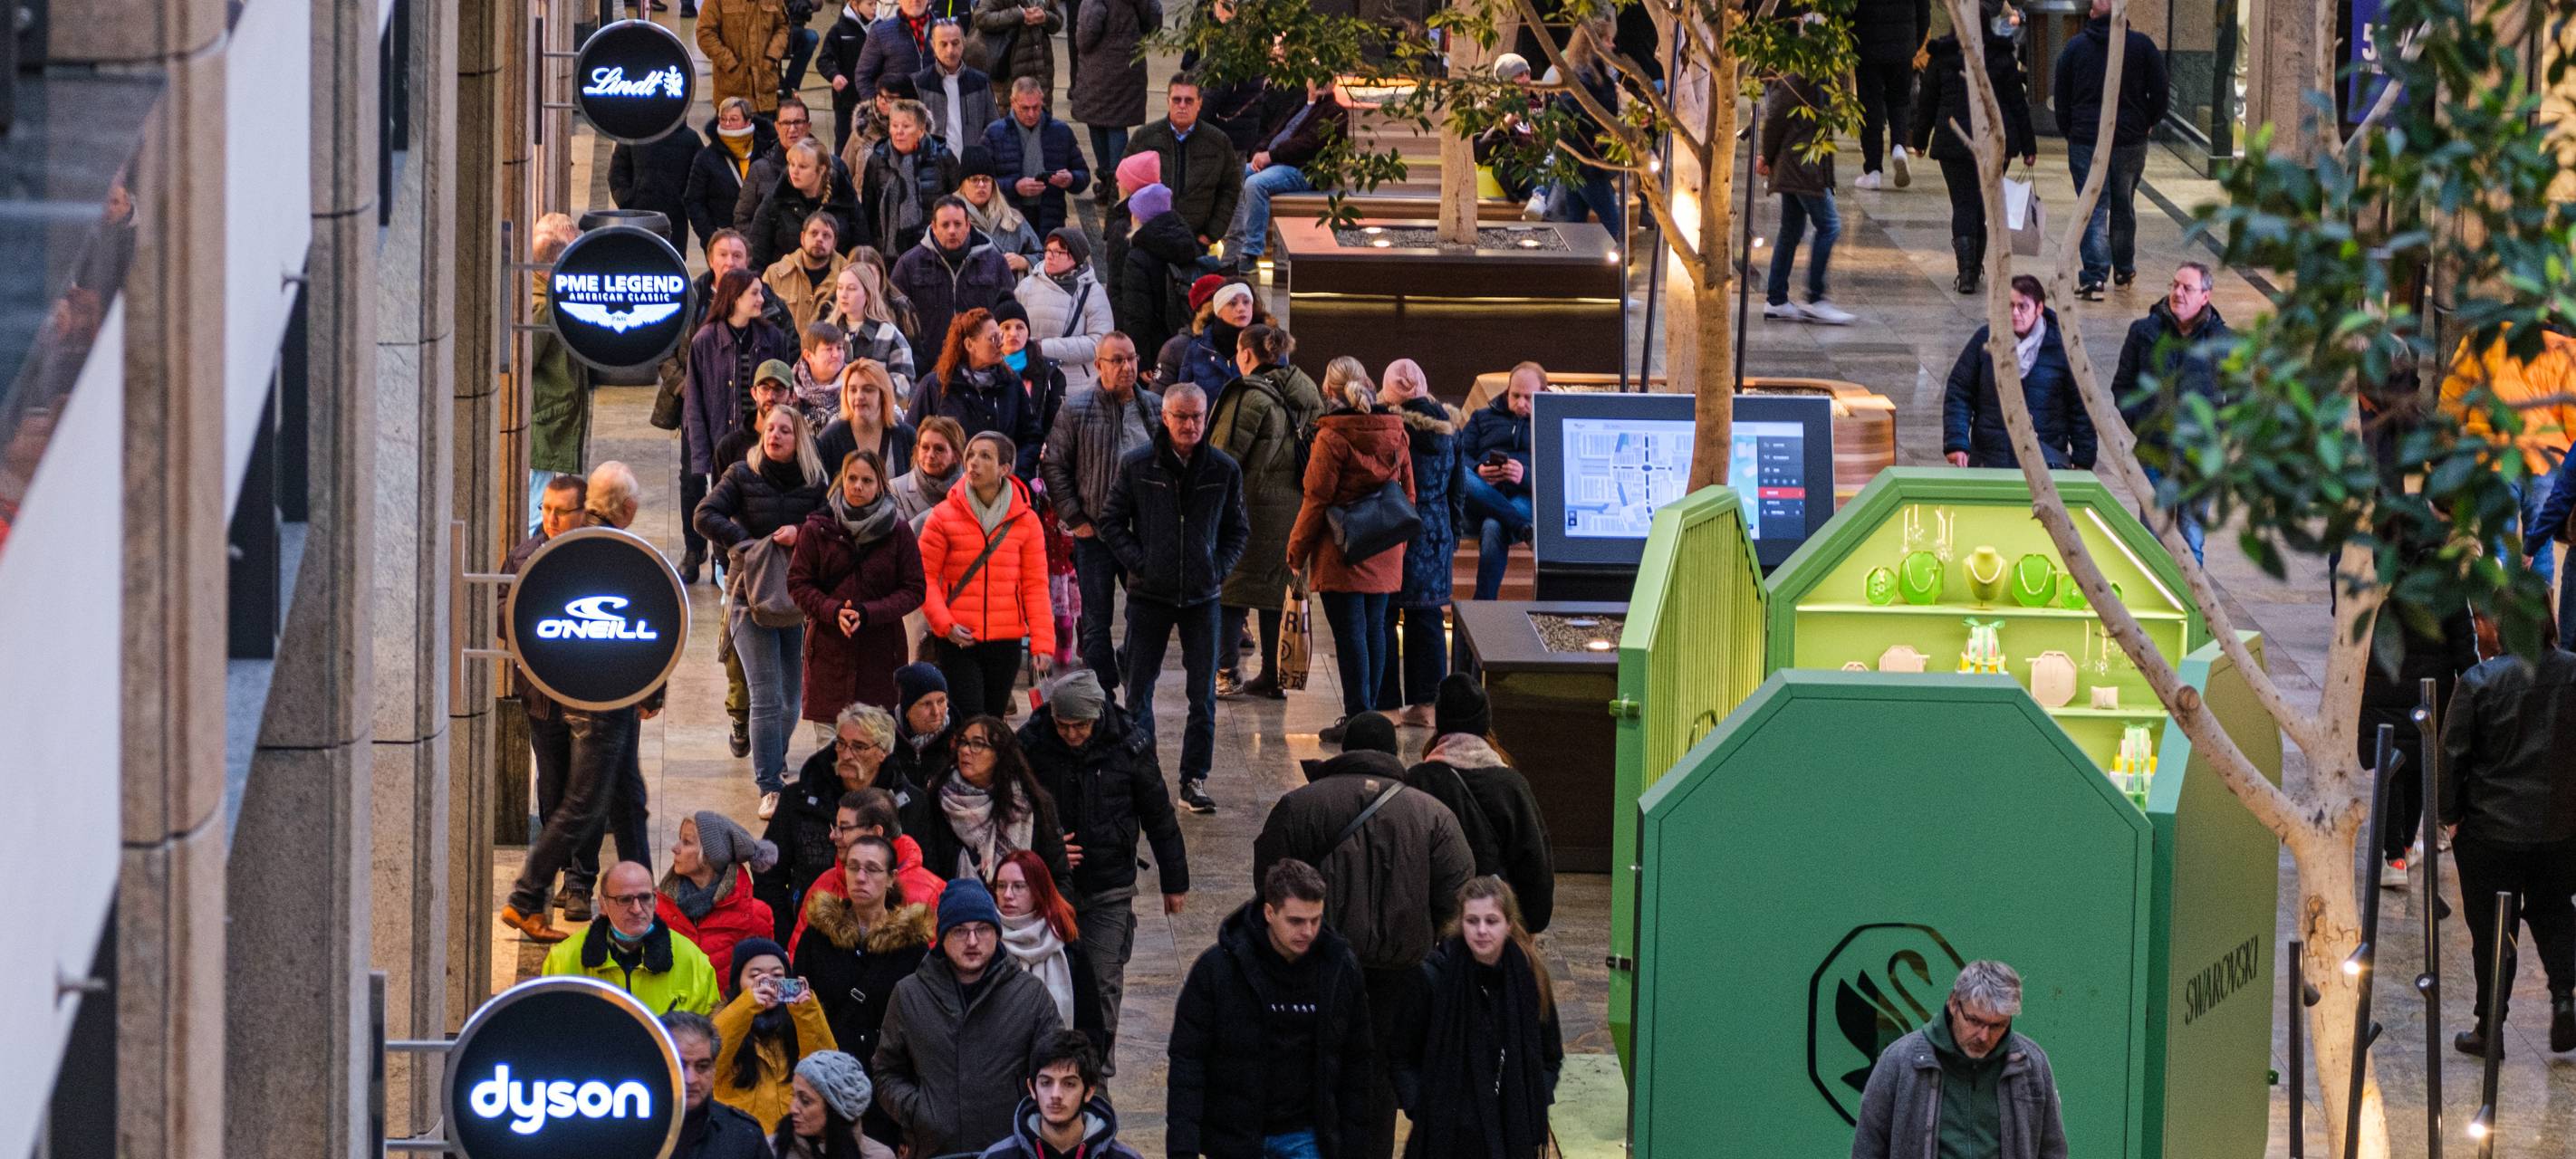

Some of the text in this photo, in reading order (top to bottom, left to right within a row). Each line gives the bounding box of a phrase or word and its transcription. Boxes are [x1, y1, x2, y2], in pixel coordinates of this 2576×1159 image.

[582, 67, 664, 96] Lindt
[555, 274, 684, 292] PME LEGEND
[569, 292, 670, 302] AMERICAN CLASSIC
[2185, 934, 2259, 1025] SWAROVSKI
[470, 1065, 650, 1135] dyson
